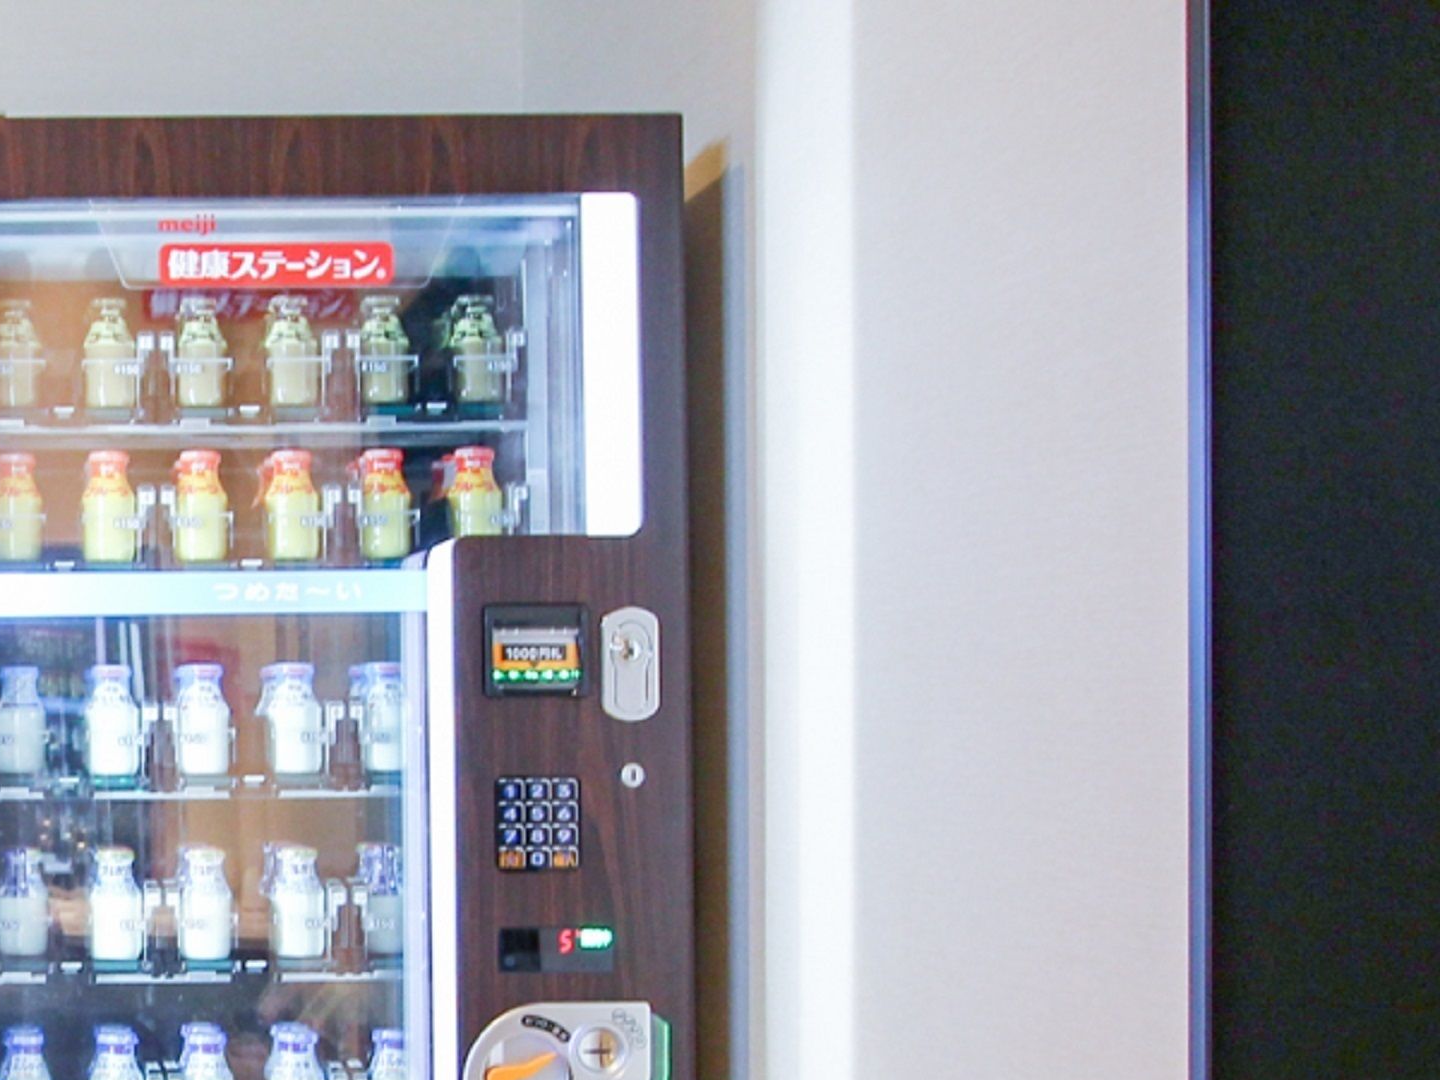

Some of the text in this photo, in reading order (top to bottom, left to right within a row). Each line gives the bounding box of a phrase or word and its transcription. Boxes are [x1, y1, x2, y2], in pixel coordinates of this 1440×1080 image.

[158, 215, 216, 235] meiji
[503, 784, 571, 798] 1 2 3
[503, 806, 571, 821] 4 5 6
[503, 829, 572, 843] 7 8 9
[531, 851, 545, 866] 0
